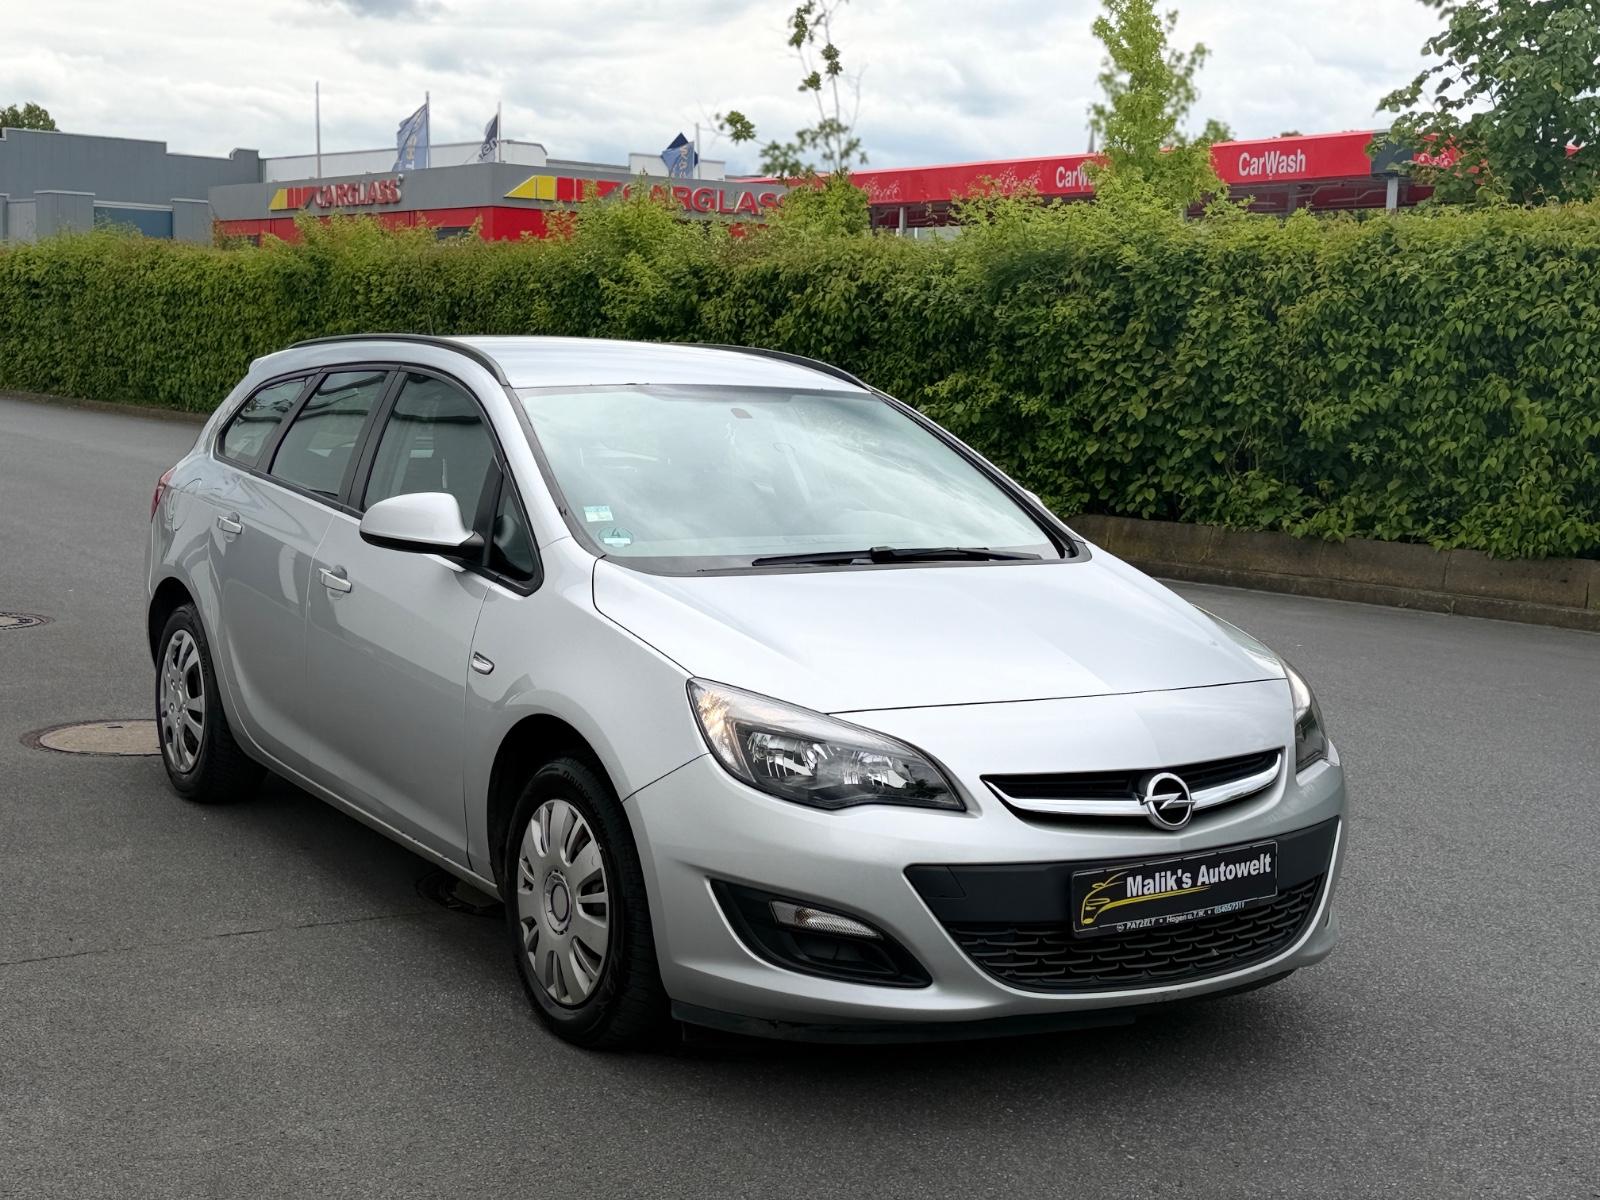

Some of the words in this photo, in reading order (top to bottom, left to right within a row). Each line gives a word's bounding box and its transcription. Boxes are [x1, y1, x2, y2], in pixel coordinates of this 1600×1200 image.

[1238, 149, 1306, 177] CarWash
[315, 180, 401, 208] CARGLASS
[1127, 869, 1192, 897] Malik's
[1197, 853, 1272, 886] Autowelt
